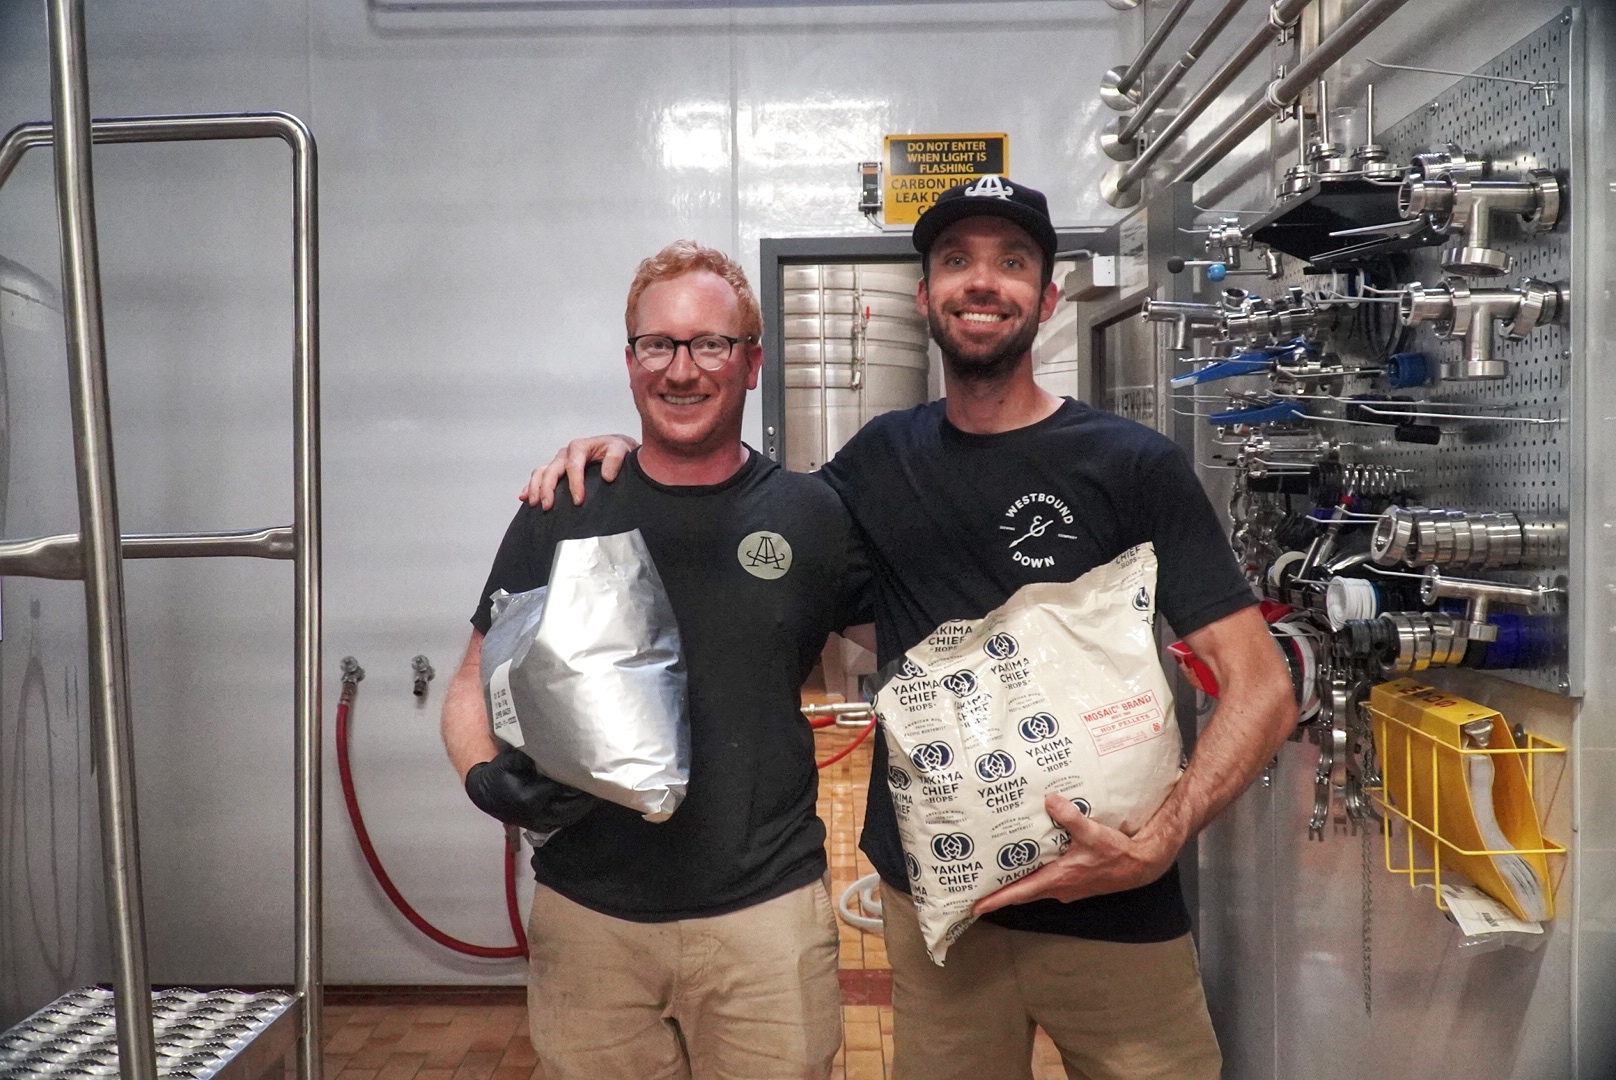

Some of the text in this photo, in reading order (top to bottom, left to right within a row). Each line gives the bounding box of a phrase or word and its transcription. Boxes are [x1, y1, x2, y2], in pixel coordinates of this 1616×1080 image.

[907, 141, 986, 152] DO NOT ENTER
[907, 152, 987, 162] WHEN LIGHT IS
[920, 163, 974, 173] FLASHING
[891, 178, 946, 190] CARBON
[895, 192, 928, 203] LEAK
[1005, 493, 1074, 524] WESTBOUND
[1012, 551, 1055, 568] DOWN
[991, 657, 1030, 675] YAKIMA
[1000, 668, 1030, 683] CHIEF
[892, 680, 940, 695] YAKIMA
[900, 691, 937, 706] CHIEF
[1121, 694, 1152, 711] BRAND
[1118, 713, 1151, 728] PELLETS
[1025, 736, 1073, 758] YAKIMA
[1036, 748, 1072, 767] CHIEF
[922, 783, 959, 796] CHIEF
[978, 776, 1028, 798] YAKIMA
[986, 788, 1025, 808] CHIEF
[931, 861, 984, 875] YAKIMA
[938, 872, 979, 886] CHIEF
